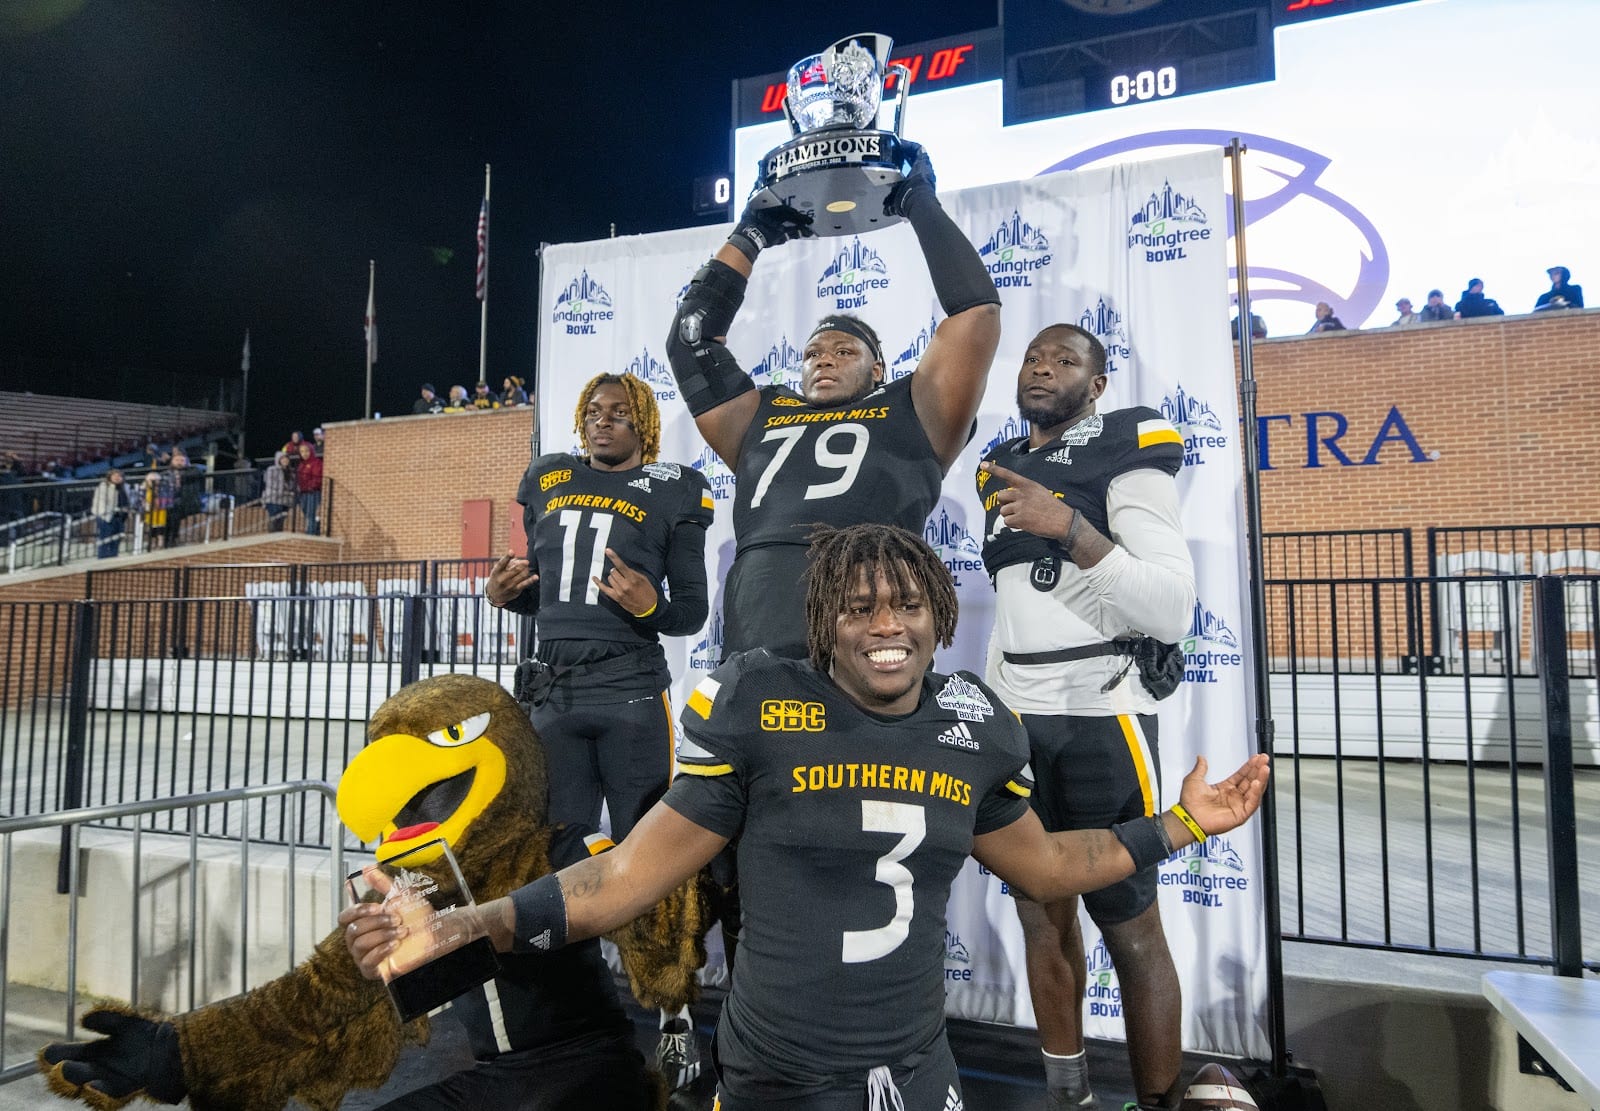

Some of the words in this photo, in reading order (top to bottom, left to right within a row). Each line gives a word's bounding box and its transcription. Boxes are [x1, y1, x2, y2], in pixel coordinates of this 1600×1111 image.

[927, 45, 973, 80] OF
[1111, 66, 1177, 104] 0:00
[767, 136, 880, 176] CHAMPIONS
[715, 178, 730, 203] 0
[985, 254, 1051, 274] ndingtree
[1146, 247, 1187, 262] BOWL
[817, 278, 889, 298] lendingtree
[994, 275, 1032, 288] BOWL
[836, 295, 868, 309] BOWL
[566, 324, 597, 335] BOWL
[764, 411, 846, 428] SOUTHERN
[848, 407, 890, 419] MISS
[750, 422, 870, 509] 79
[1045, 455, 1073, 465] adidas
[545, 494, 613, 515] SOUTHERN
[612, 499, 647, 523] MISS
[559, 510, 614, 605] 11
[761, 700, 826, 732] SBC
[940, 700, 992, 713] lendingtree
[959, 711, 983, 721] BOWL
[938, 735, 980, 750] adidas
[792, 763, 926, 793] SOUTHERN
[929, 771, 972, 806] MISS
[842, 799, 927, 963] 3
[1183, 890, 1222, 907] BOWL
[1090, 1002, 1121, 1017] BOW
